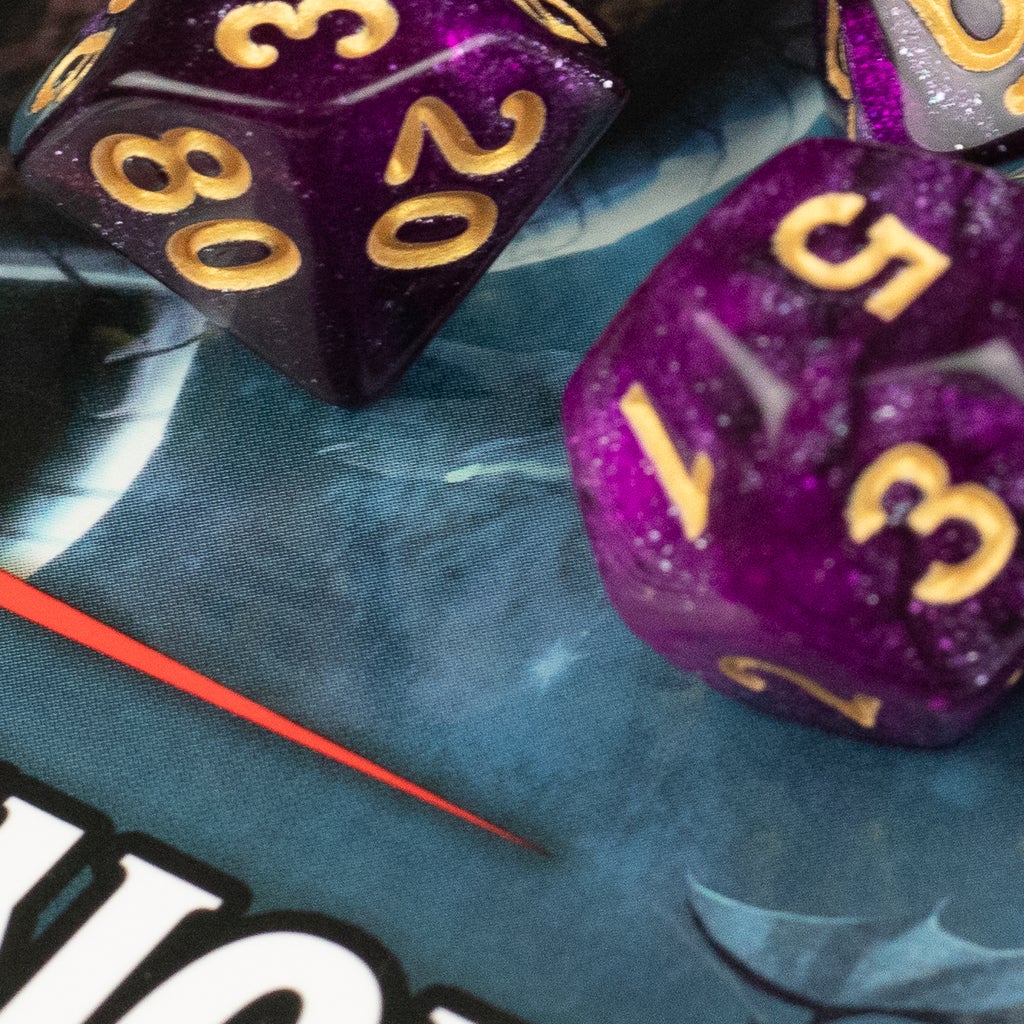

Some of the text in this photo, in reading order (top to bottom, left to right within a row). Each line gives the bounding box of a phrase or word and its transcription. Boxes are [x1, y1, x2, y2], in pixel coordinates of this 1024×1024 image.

[91, 128, 302, 292] 80
[368, 92, 546, 271] 20
[774, 195, 950, 319] 5
[623, 388, 713, 539] 1
[848, 446, 1018, 604] 3
